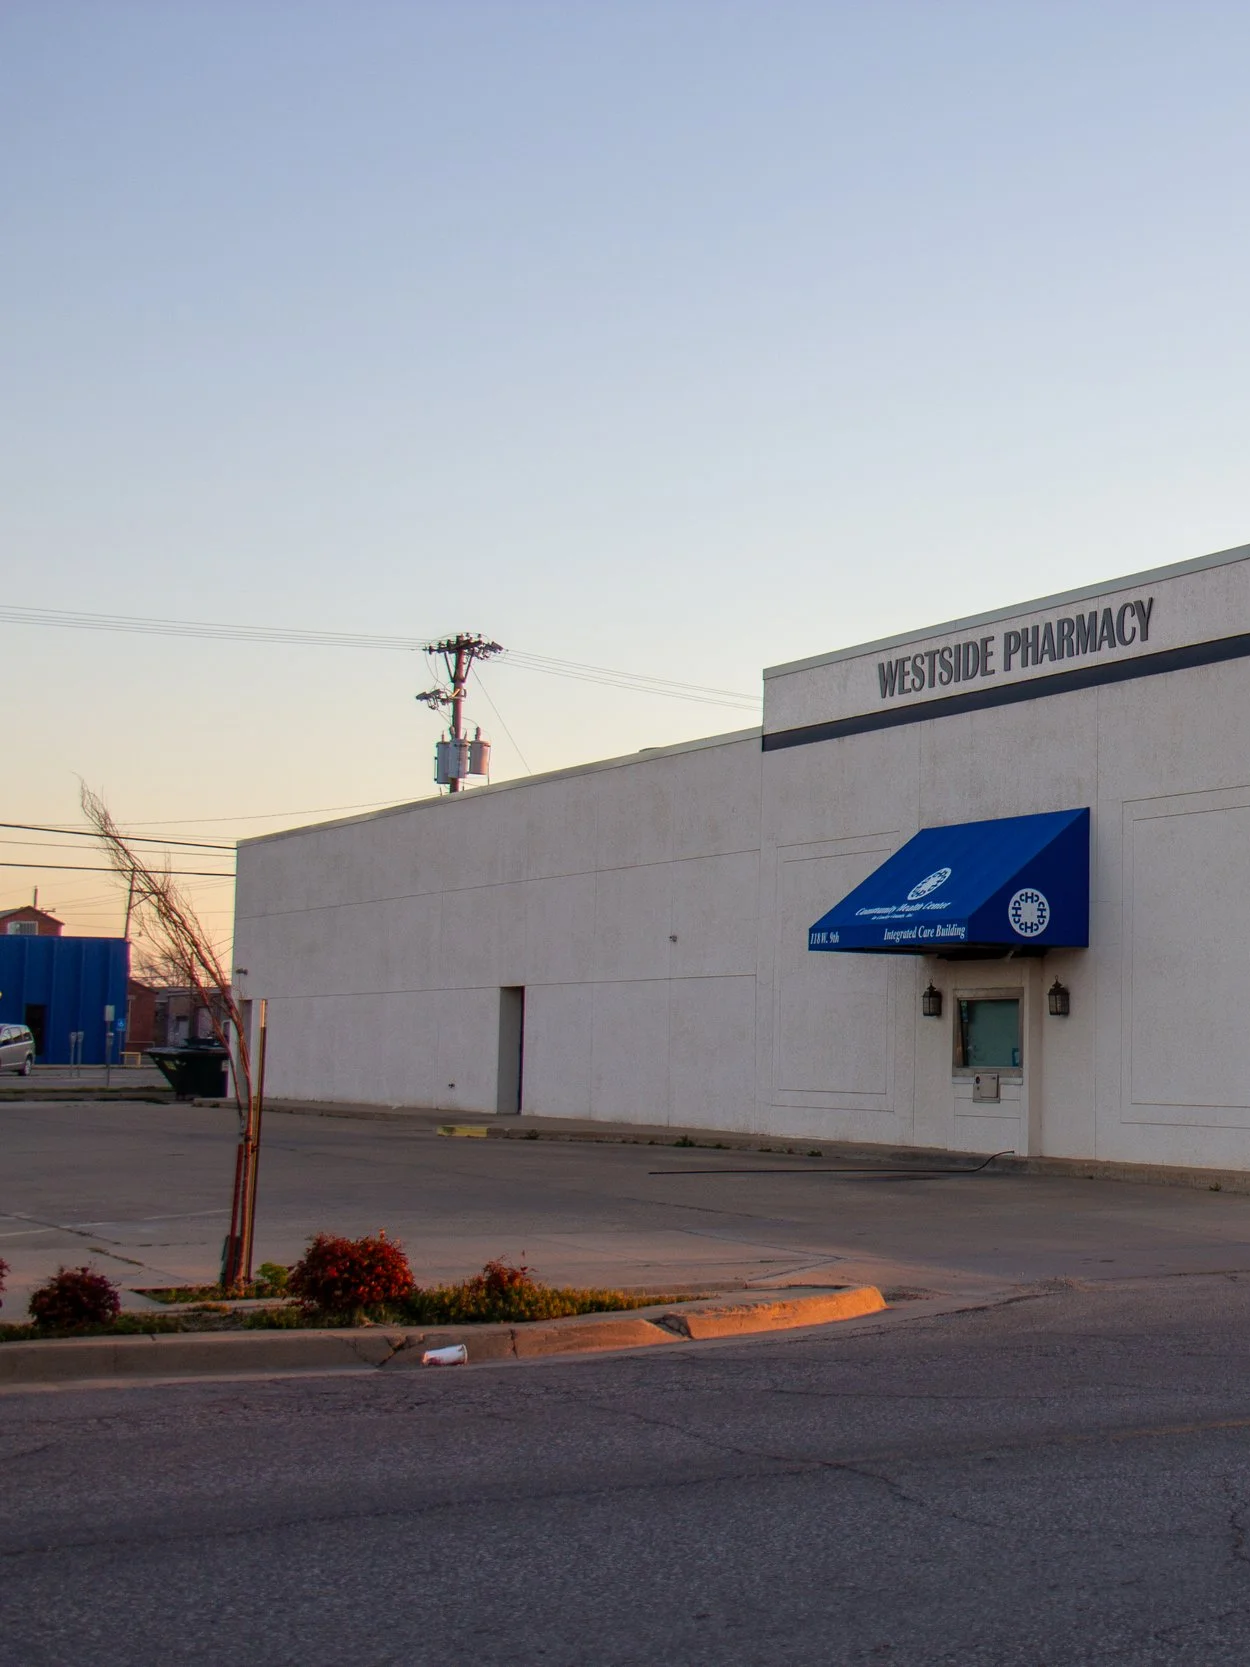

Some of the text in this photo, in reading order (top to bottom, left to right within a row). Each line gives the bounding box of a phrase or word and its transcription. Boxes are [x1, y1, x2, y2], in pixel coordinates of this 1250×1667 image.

[878, 597, 1154, 699] WESTSIDE PHARMACY
[884, 923, 966, 943] Integrated Care Building
